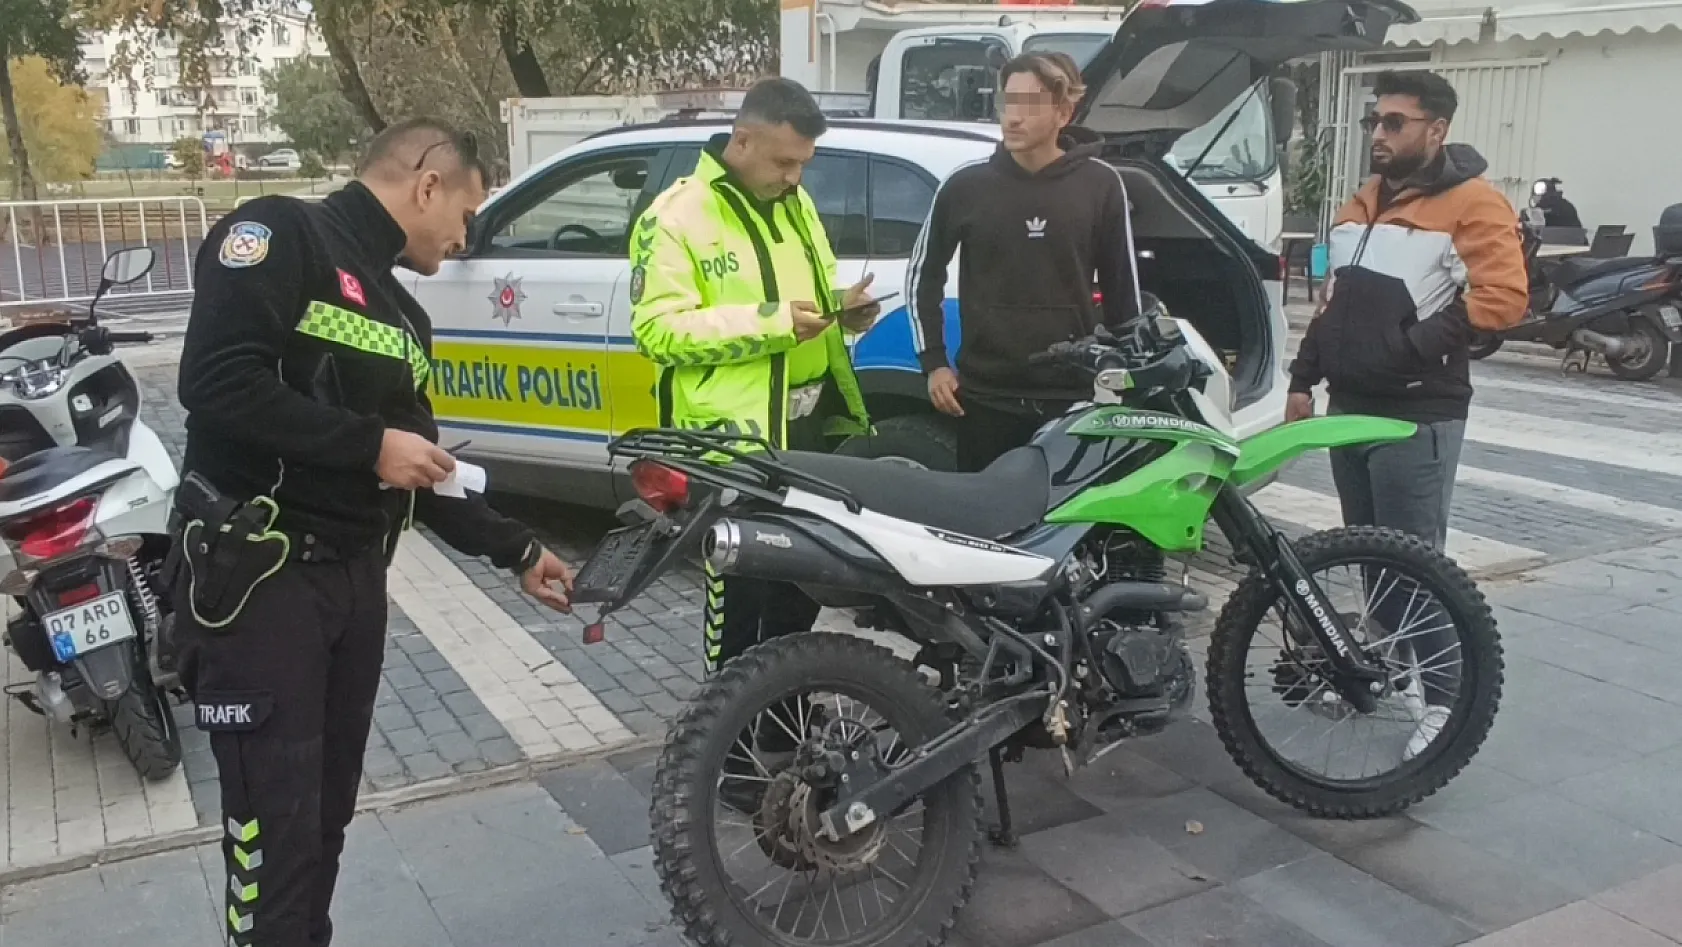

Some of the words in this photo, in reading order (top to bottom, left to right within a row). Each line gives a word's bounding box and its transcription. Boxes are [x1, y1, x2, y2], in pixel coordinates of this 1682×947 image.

[430, 356, 512, 402] TRAFİK
[517, 362, 602, 410] POLİSİ
[1132, 415, 1200, 430] MONDIAL
[51, 613, 75, 634] 07
[82, 599, 120, 625] ARD
[1304, 594, 1349, 658] MONDIAL
[85, 624, 110, 645] 66
